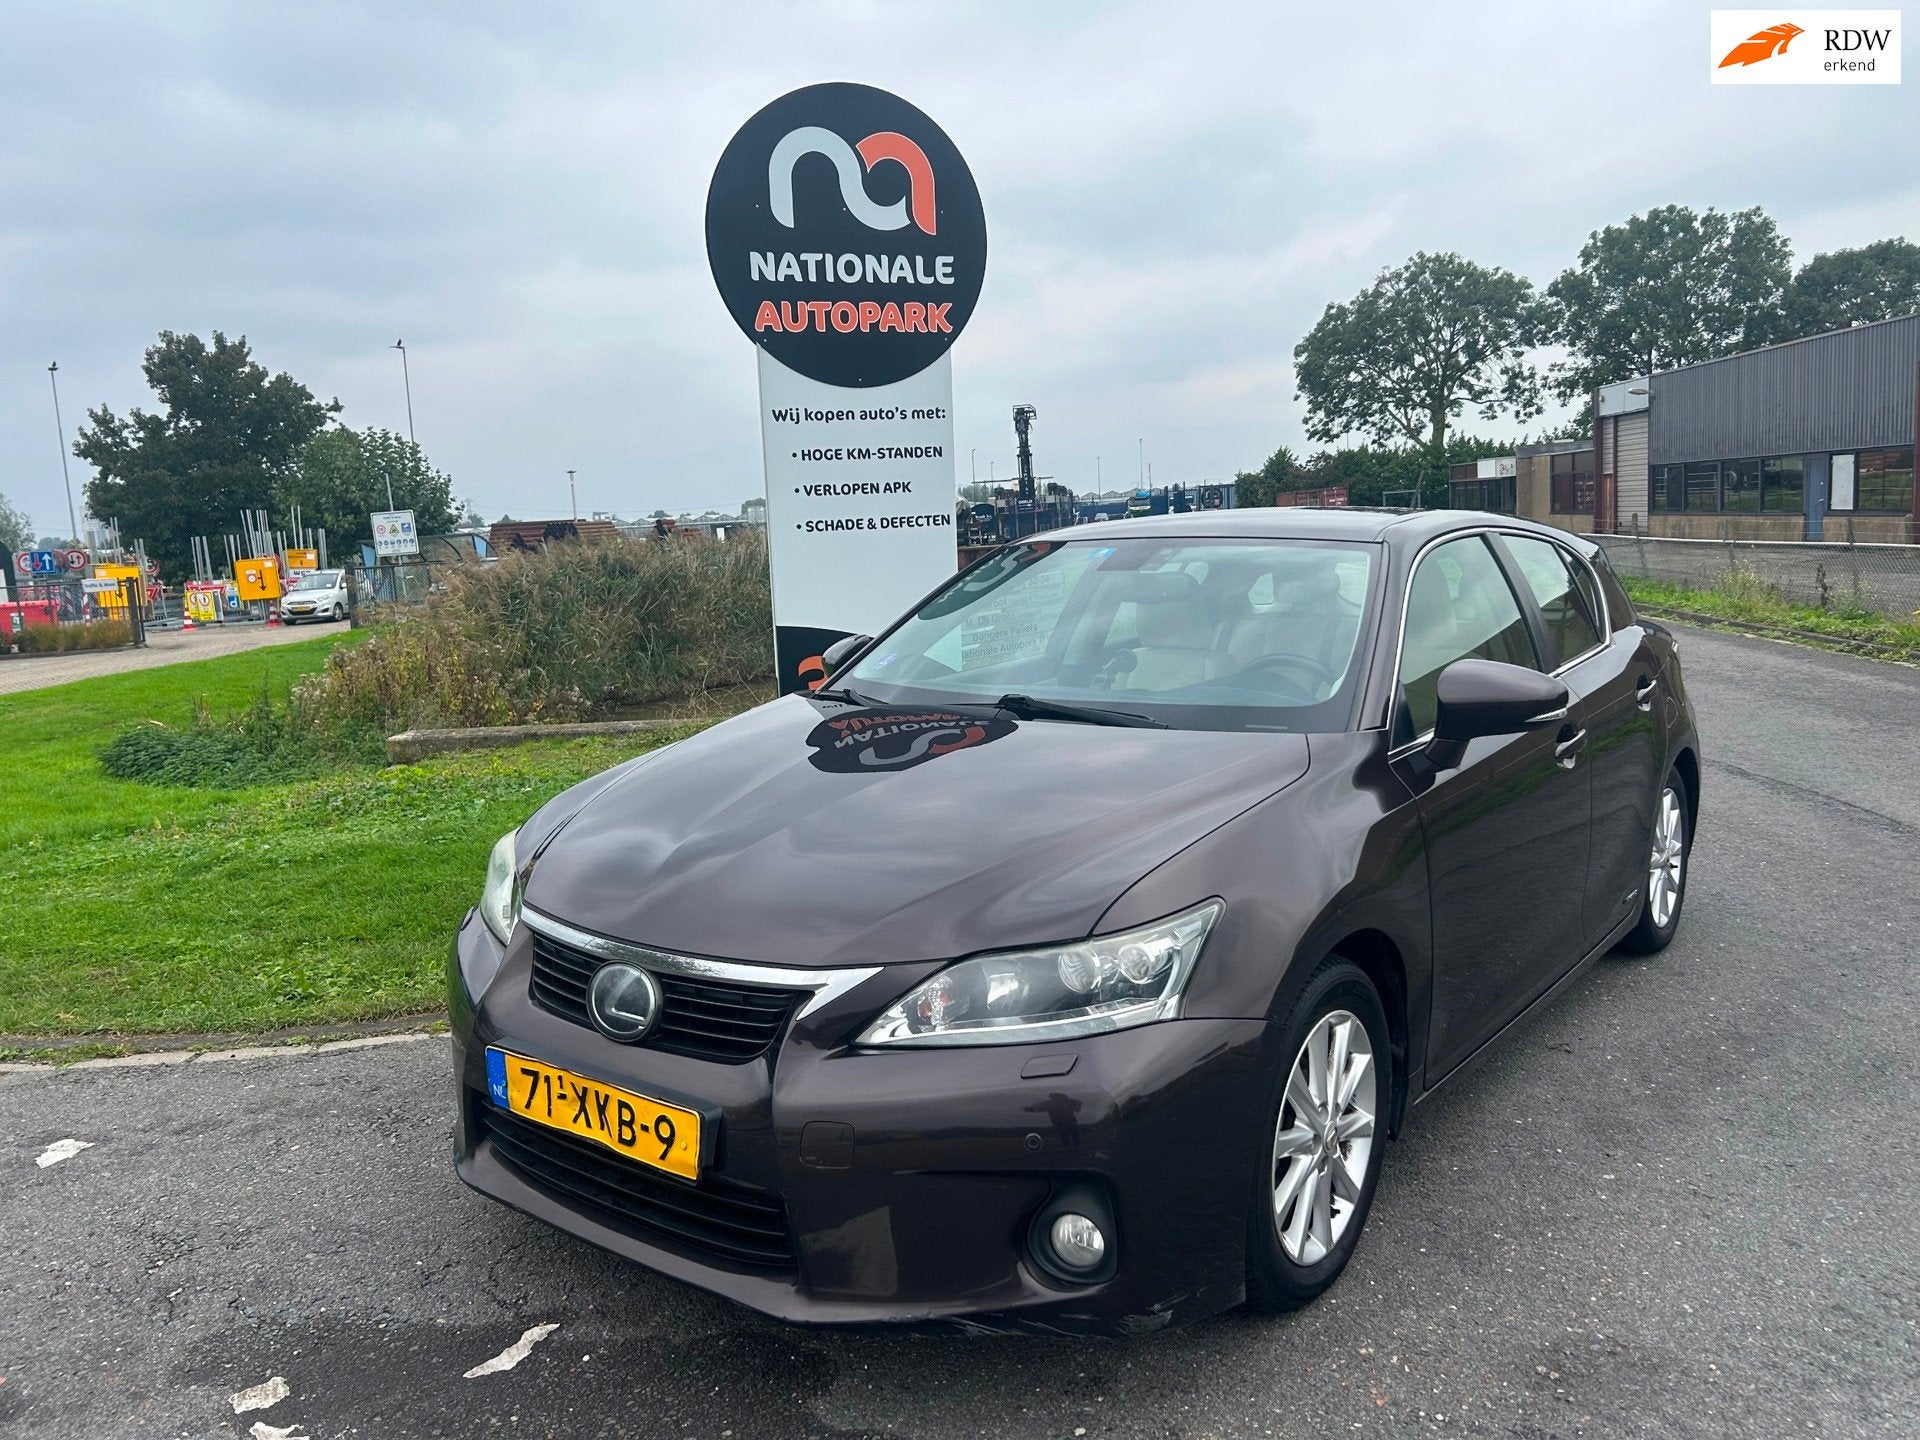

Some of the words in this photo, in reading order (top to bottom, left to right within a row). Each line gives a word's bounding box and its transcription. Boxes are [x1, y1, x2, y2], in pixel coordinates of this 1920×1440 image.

[749, 251, 955, 285] NATIONALE
[755, 300, 953, 333] AUTOPARK
[771, 407, 800, 425] Wij
[804, 407, 855, 423] kopen
[859, 406, 908, 421] auto's
[911, 406, 946, 420] met:
[801, 448, 843, 461] HOGE
[847, 446, 943, 460] KM-STANDEN
[803, 482, 880, 497] VERLOPEN
[883, 481, 912, 494] APK
[805, 518, 864, 533] SCHADE
[867, 517, 877, 530] &
[880, 513, 951, 529] DEFECTEN
[520, 1066, 676, 1161] 71-XKB-9
